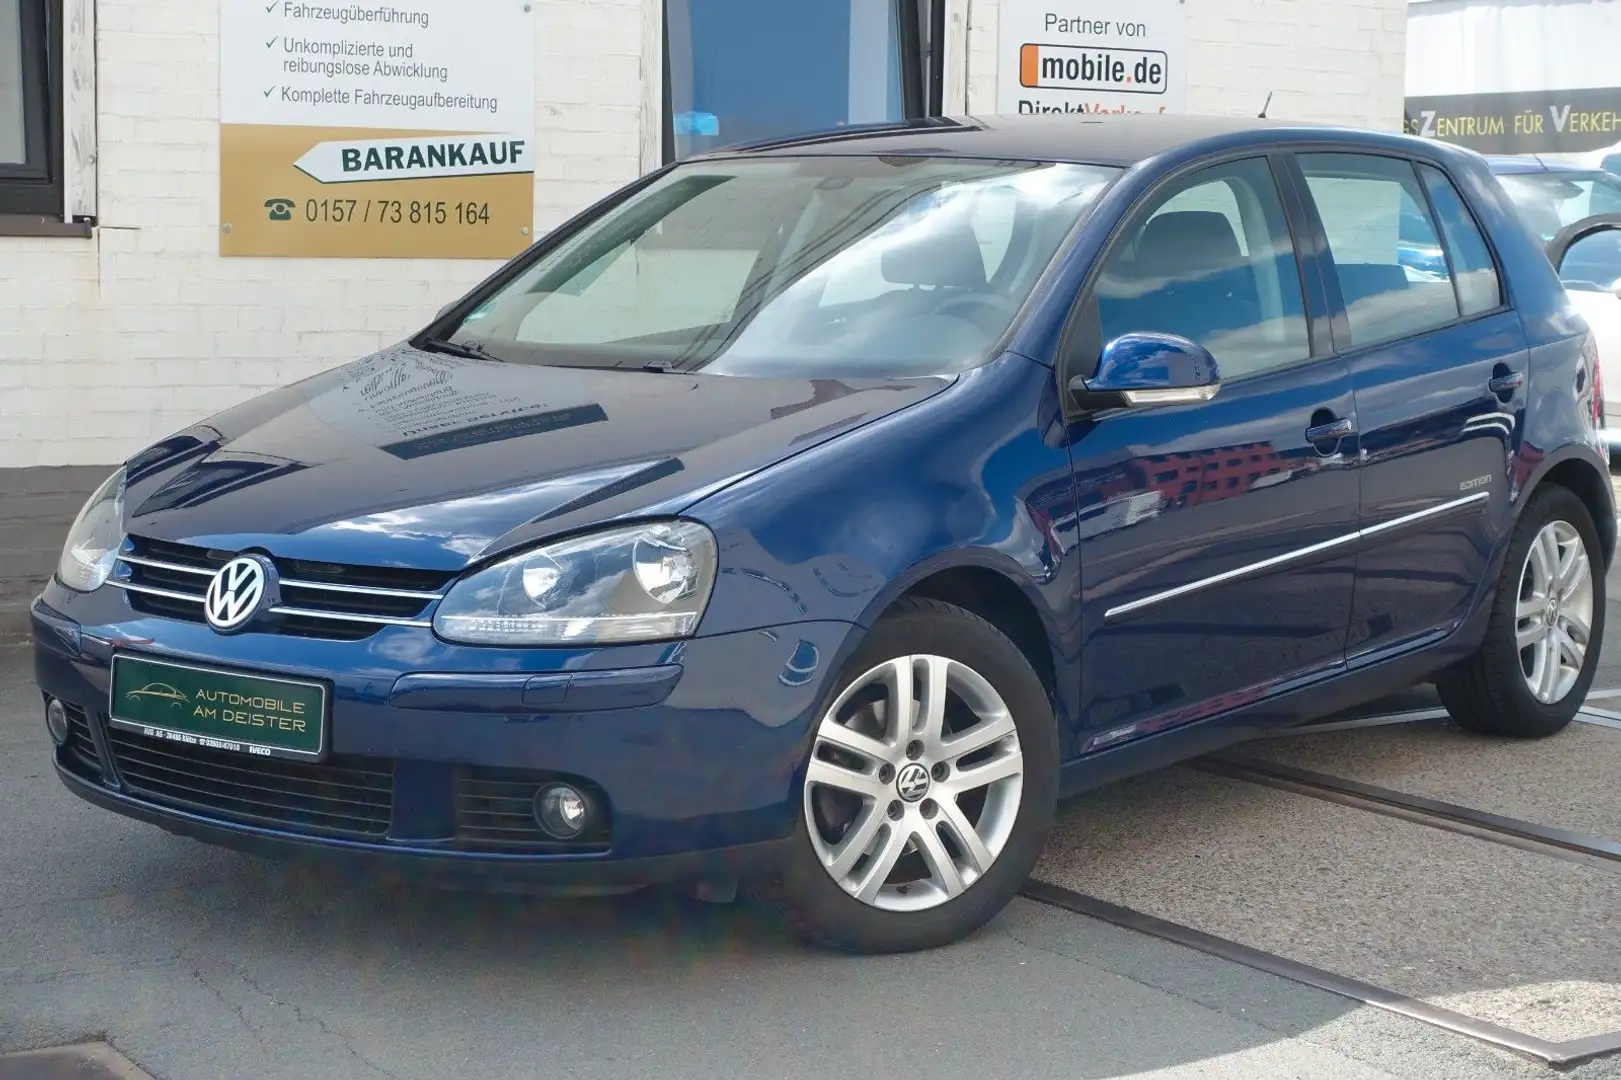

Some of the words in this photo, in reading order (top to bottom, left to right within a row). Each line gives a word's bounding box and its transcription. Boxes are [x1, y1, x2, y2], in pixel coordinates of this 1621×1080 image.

[284, 2, 429, 28] Fahrzeugüberführung
[1045, 13, 1110, 35] Partner
[1116, 22, 1146, 37] von
[284, 38, 384, 58] Unkomplizierte
[388, 44, 413, 58] und
[283, 58, 370, 78] reibungslose
[373, 61, 448, 82] Abwicklung
[1042, 53, 1161, 84] mobile.de
[281, 86, 350, 106] Komplette
[354, 89, 498, 113] Fahrzeugaufbereitung
[1514, 109, 1543, 134] FÜR
[341, 140, 525, 172] BARANKAUF
[305, 198, 357, 222] 0157
[378, 200, 402, 223] 73
[409, 200, 446, 224] 815
[455, 202, 490, 224] 164
[195, 688, 305, 714] AUTOMOBILE
[193, 705, 217, 719] AM
[222, 710, 306, 732] DEISTER
[249, 745, 271, 756] IVECO
